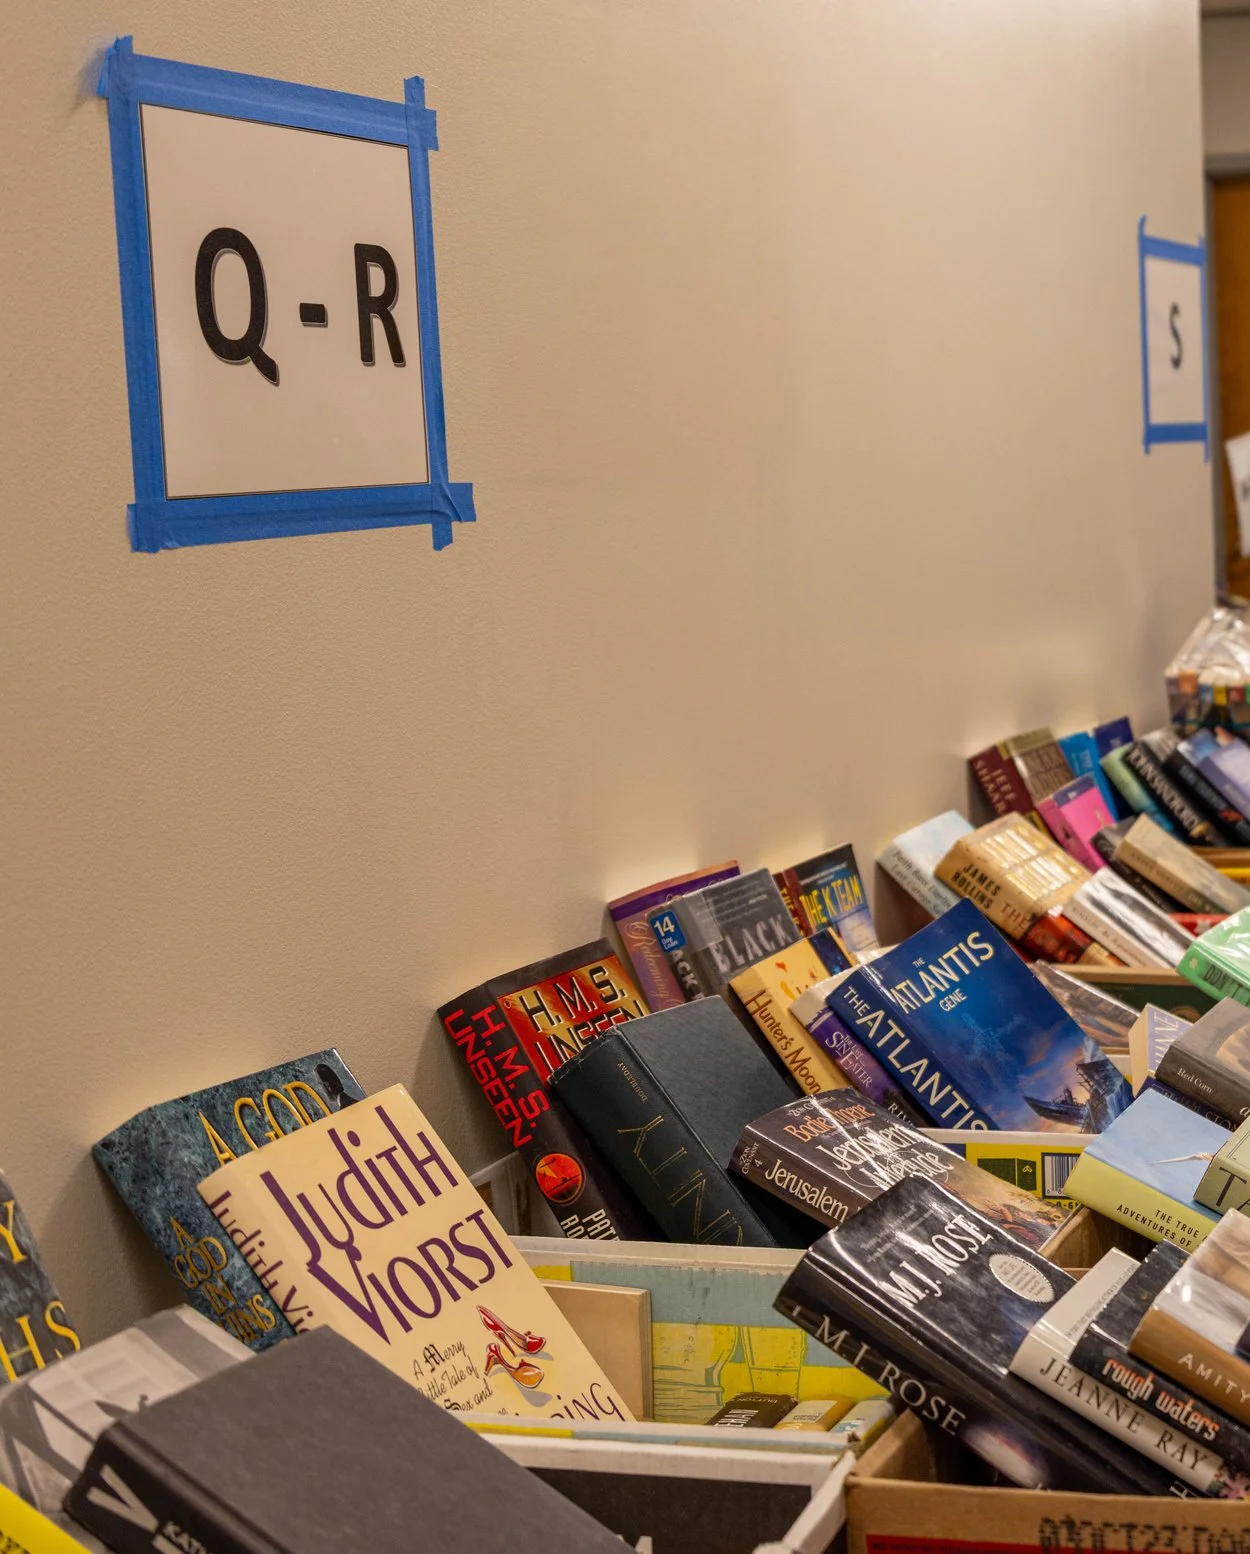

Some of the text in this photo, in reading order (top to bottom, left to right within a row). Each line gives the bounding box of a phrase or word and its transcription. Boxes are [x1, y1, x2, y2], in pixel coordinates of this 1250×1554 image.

[194, 227, 279, 385] Q
[354, 242, 406, 367] R
[1169, 301, 1183, 371] S
[951, 870, 993, 911] ROLLINS
[961, 863, 1001, 896] JAMES
[799, 874, 863, 934] THE K TEAM
[1000, 901, 1030, 931] THE
[653, 916, 676, 938] 14
[709, 913, 792, 974] BLACK
[671, 950, 699, 991] ACK
[890, 931, 995, 1016] ATLANTIS
[911, 956, 926, 968] THE
[745, 988, 795, 1052] Hunter's
[843, 987, 870, 1016] THE
[938, 990, 968, 1013] GENE
[444, 1008, 533, 1148] UNSEEN
[616, 1061, 649, 1102] DOUBLEDAY
[784, 1046, 822, 1095] Moon
[1177, 1067, 1197, 1083] Red
[1194, 1077, 1213, 1094] Corn
[199, 1080, 333, 1167] A GOD
[754, 1159, 764, 1168] 4
[764, 1159, 849, 1223] Jerusalem
[169, 1216, 195, 1249] A
[208, 1190, 284, 1293] Judith
[1116, 1204, 1194, 1249] ADVENTURES OF
[1154, 1209, 1200, 1236] THE TRUE
[173, 1236, 229, 1288] GOD
[916, 1214, 995, 1277] ROSE
[203, 1274, 236, 1317] IN
[413, 1340, 466, 1381] A Merry
[442, 1366, 468, 1392] Tale
[466, 1356, 479, 1381] of
[473, 1380, 495, 1406] and
[877, 1362, 967, 1437] ROSE
[1039, 1357, 1208, 1472] JEANNE RAY
[1101, 1358, 1220, 1443] rough waters
